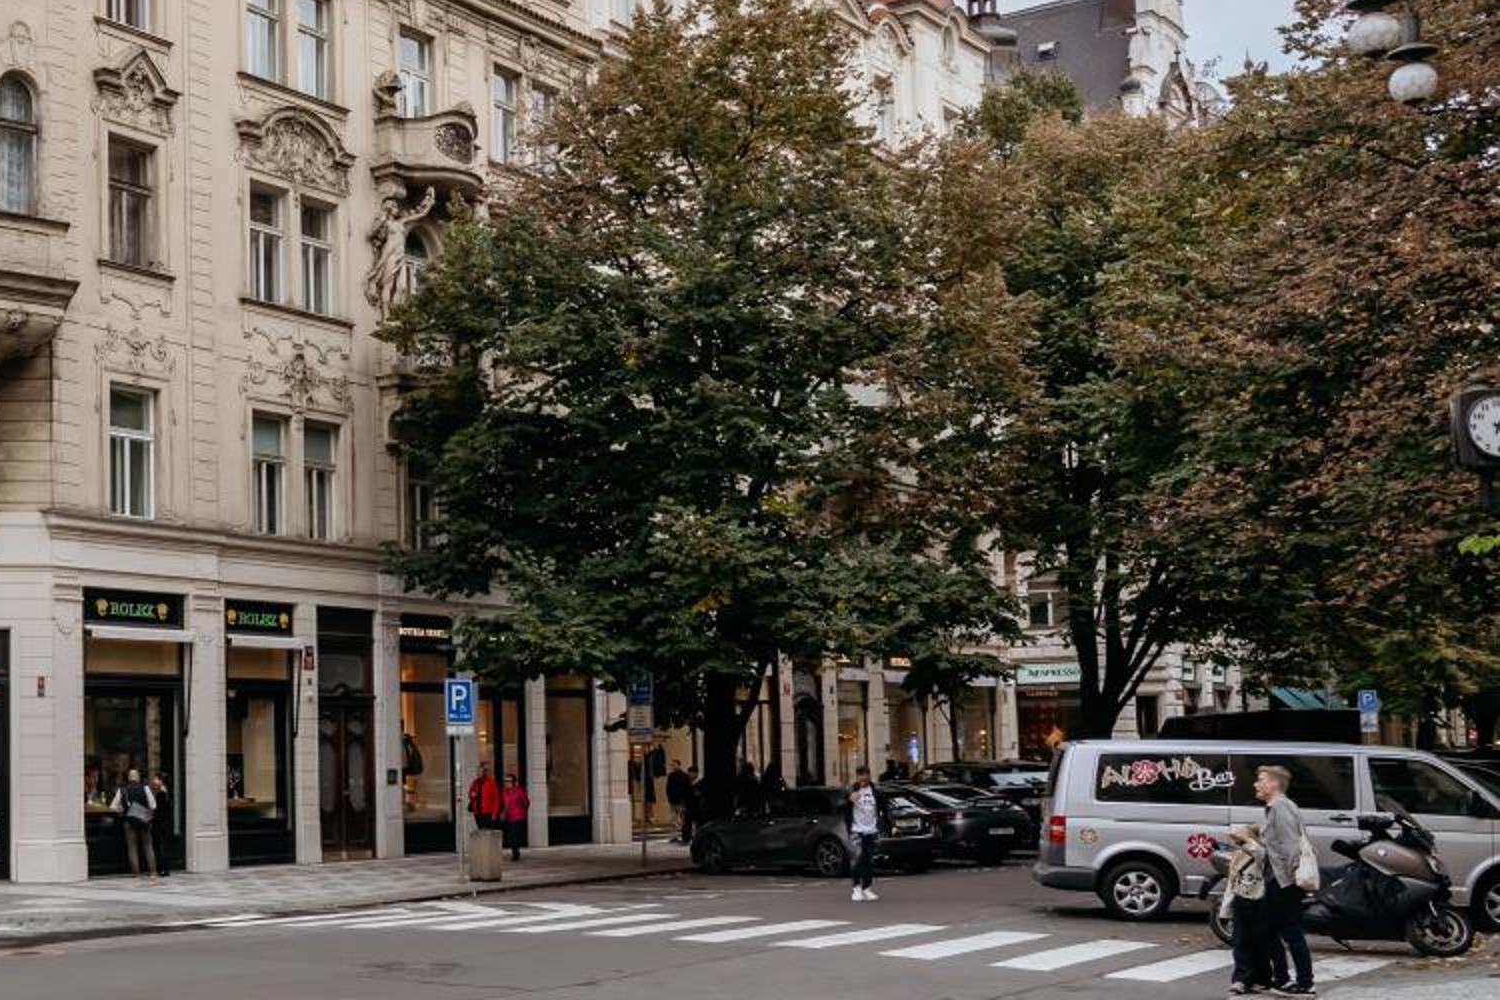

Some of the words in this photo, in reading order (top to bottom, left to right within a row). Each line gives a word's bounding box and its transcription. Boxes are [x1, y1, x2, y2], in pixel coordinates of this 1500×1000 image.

[110, 601, 156, 618] ROLEX
[239, 611, 278, 627] ROLEX
[451, 684, 467, 711] P
[1363, 693, 1373, 706] P
[1188, 767, 1236, 791] Bar
